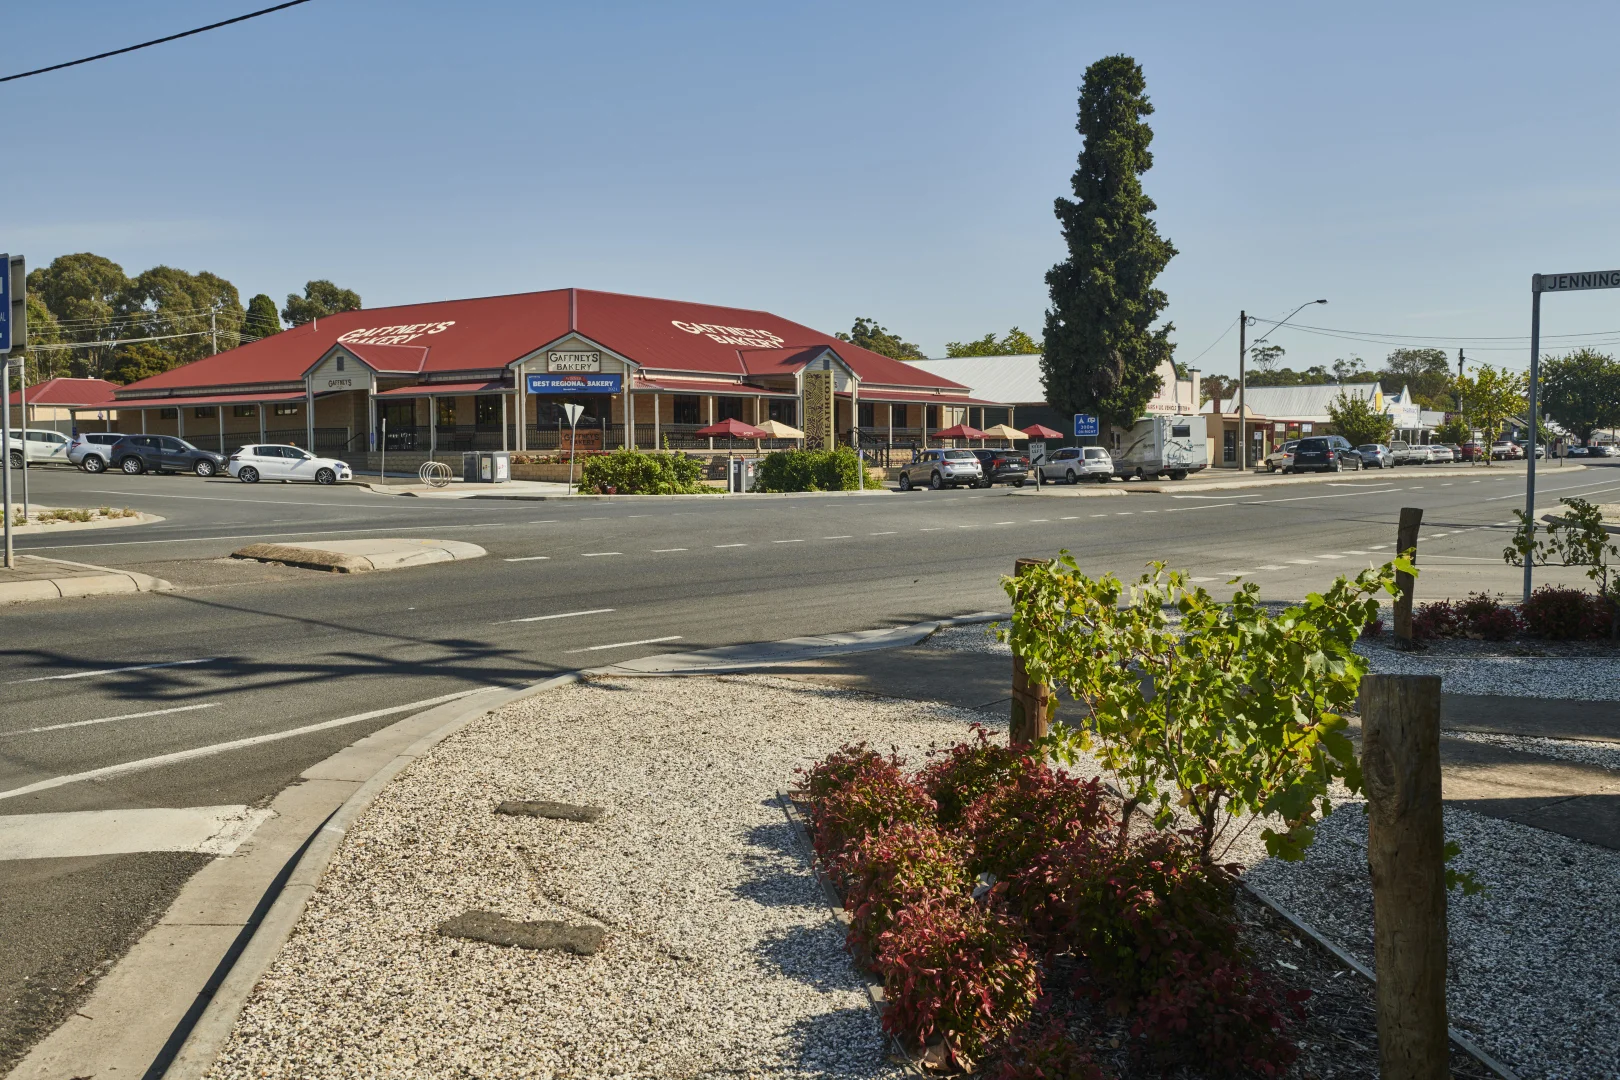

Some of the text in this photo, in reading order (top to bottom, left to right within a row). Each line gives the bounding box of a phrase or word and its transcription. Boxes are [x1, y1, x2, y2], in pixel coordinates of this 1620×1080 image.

[705, 333, 783, 349] BAKERY
[549, 352, 599, 363] GAFFNEY'S
[556, 363, 592, 371] BAKERY
